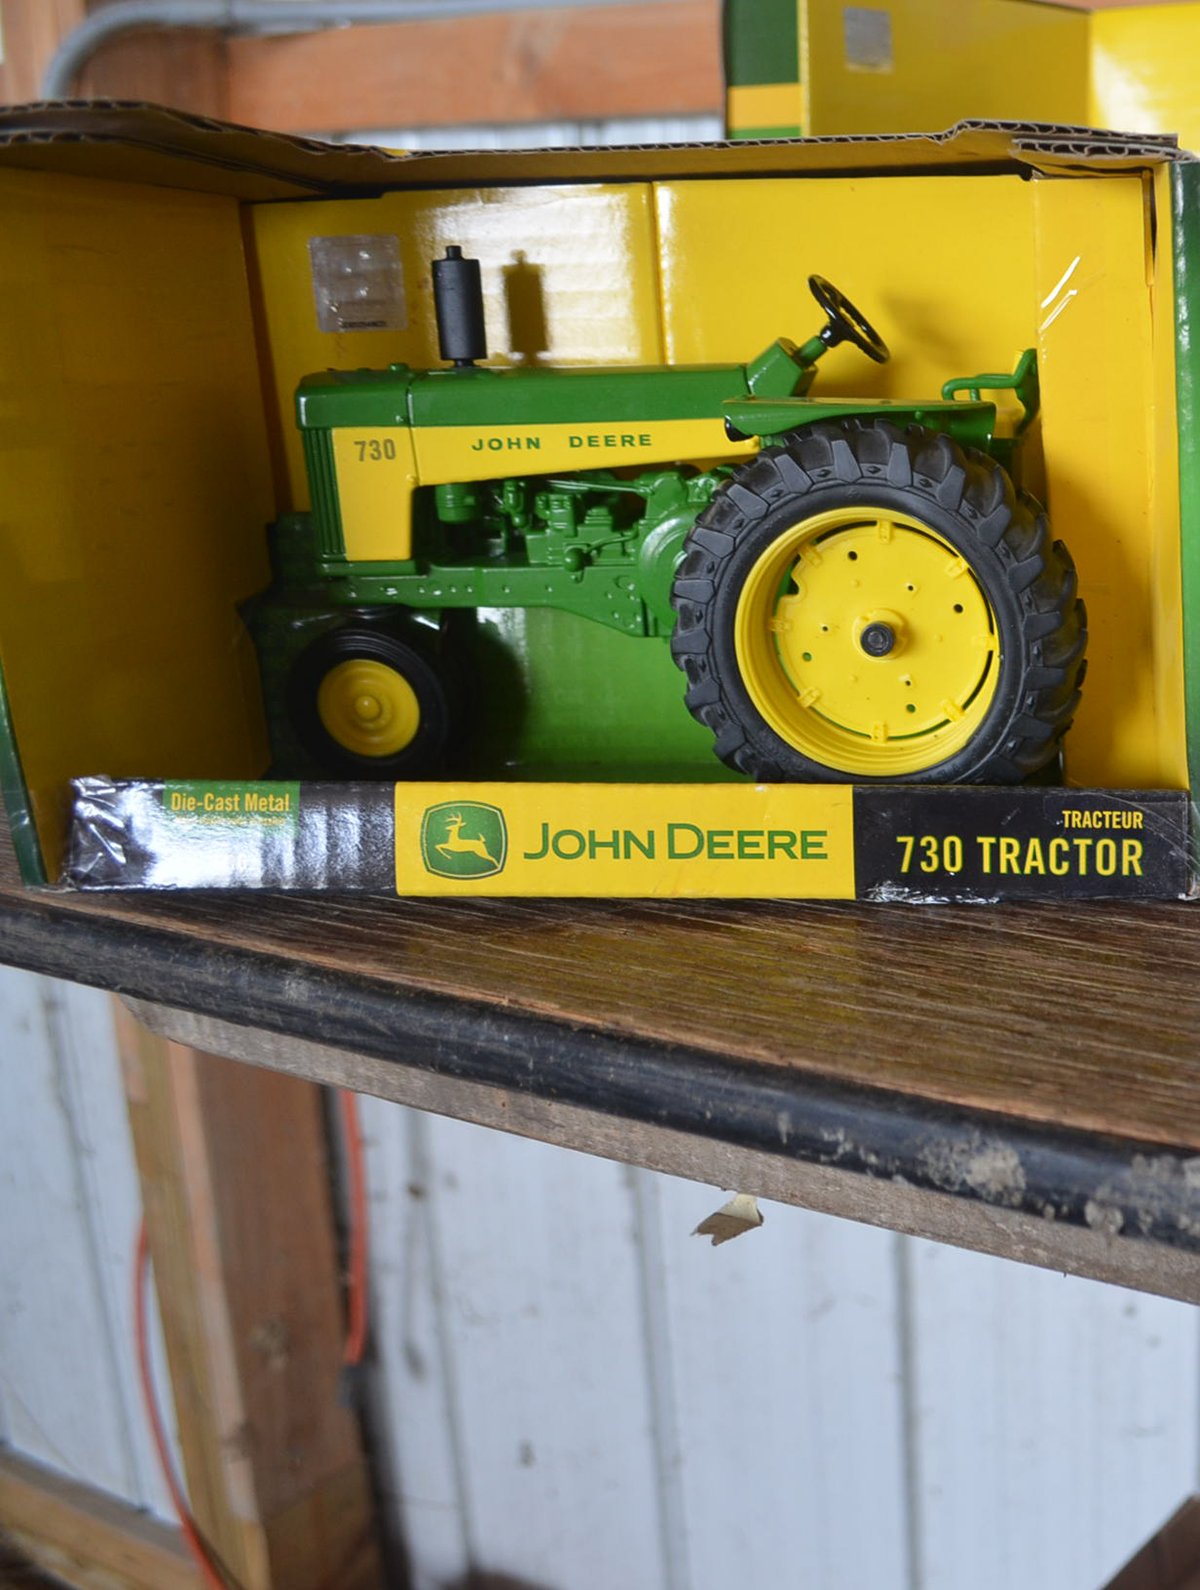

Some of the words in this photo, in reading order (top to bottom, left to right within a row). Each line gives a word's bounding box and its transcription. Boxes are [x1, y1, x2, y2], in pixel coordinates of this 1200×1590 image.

[353, 439, 398, 462] 730
[471, 437, 541, 452] JOHN
[569, 433, 653, 449] DEERE
[170, 792, 241, 812] Die-Cast
[244, 792, 290, 812] Metal
[1061, 809, 1144, 830] TRACTEUR
[522, 821, 655, 860] JOHN
[667, 822, 829, 860] DEERE
[896, 834, 964, 874] 730
[976, 836, 1145, 877] TRACTOR
